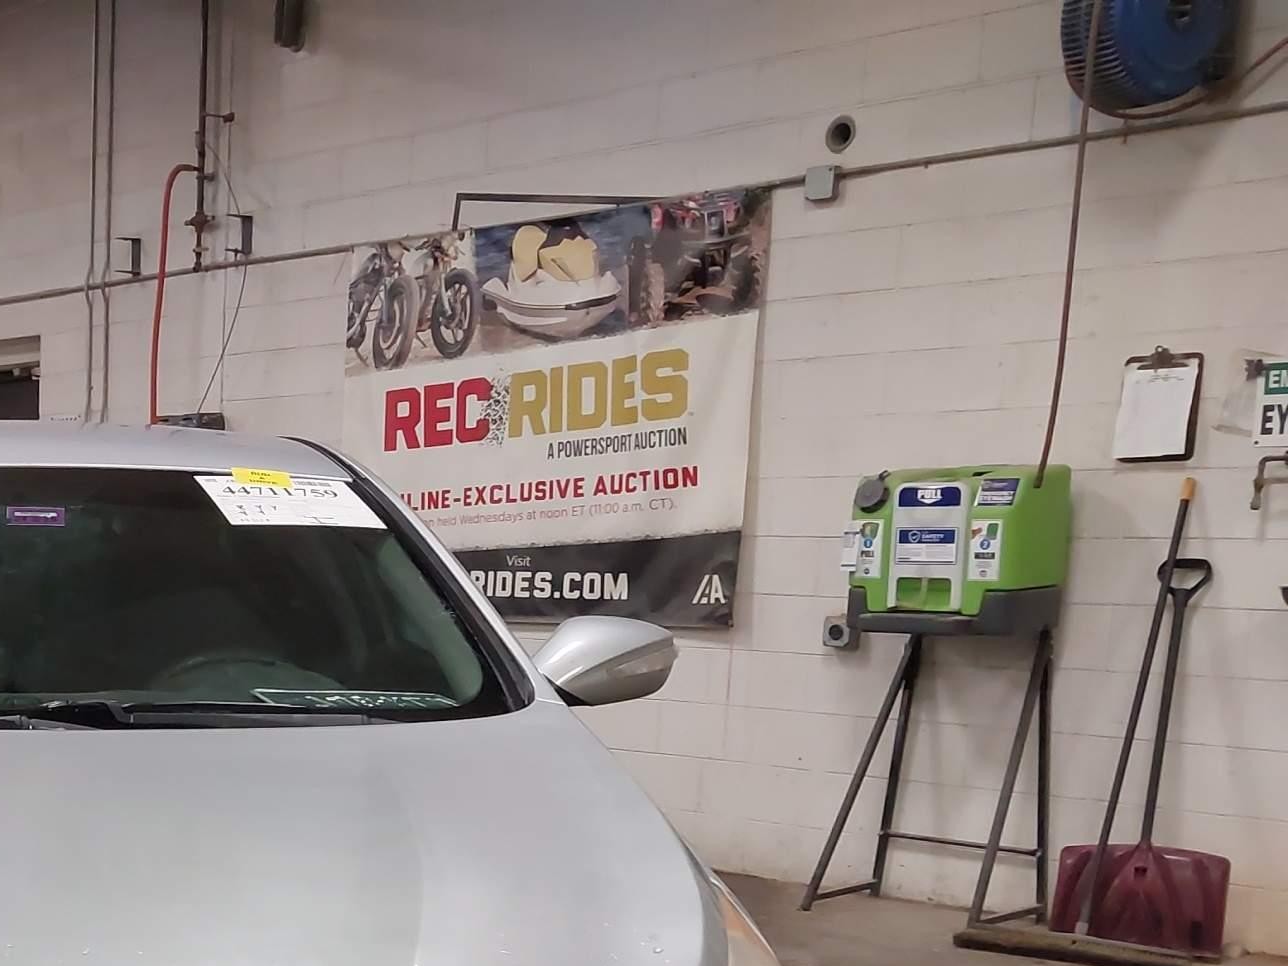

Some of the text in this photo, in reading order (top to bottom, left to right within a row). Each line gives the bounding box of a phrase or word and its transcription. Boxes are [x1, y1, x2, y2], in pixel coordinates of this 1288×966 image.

[383, 348, 690, 453] REC RIDES
[547, 426, 688, 460] A POWERSPORT AUCTION
[222, 485, 339, 499] 44711759
[400, 465, 698, 511] LINE-EXCLUSIVE AUCTION
[460, 510, 523, 526] Wednesdays
[525, 510, 537, 521] at
[539, 508, 568, 519] noon
[571, 505, 586, 517] ET
[506, 555, 531, 567] Visit
[470, 570, 629, 600] RIDES.COM
